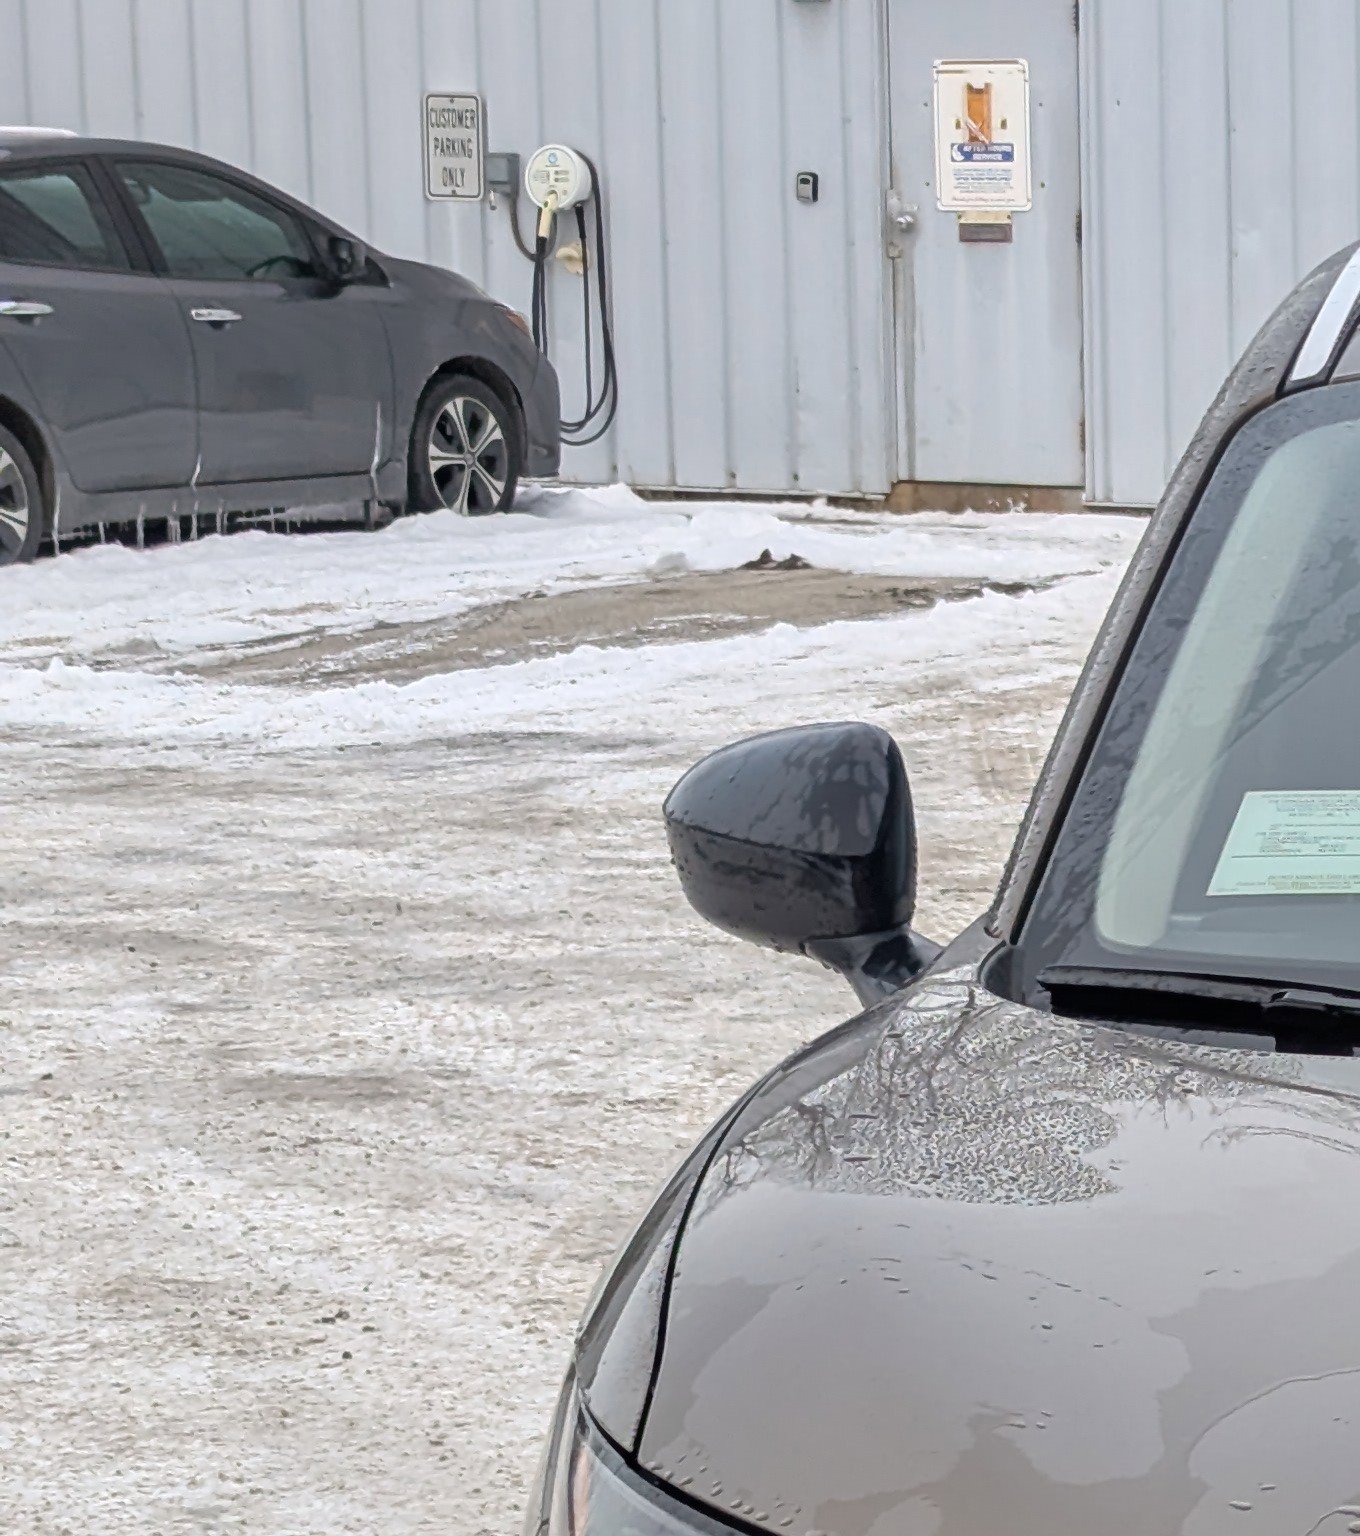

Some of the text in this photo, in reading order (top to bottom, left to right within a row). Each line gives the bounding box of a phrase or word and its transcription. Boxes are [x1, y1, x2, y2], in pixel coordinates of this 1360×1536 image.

[429, 108, 476, 129] CUSTOMER
[433, 137, 473, 158] PARKING
[441, 166, 466, 187] ONLY
